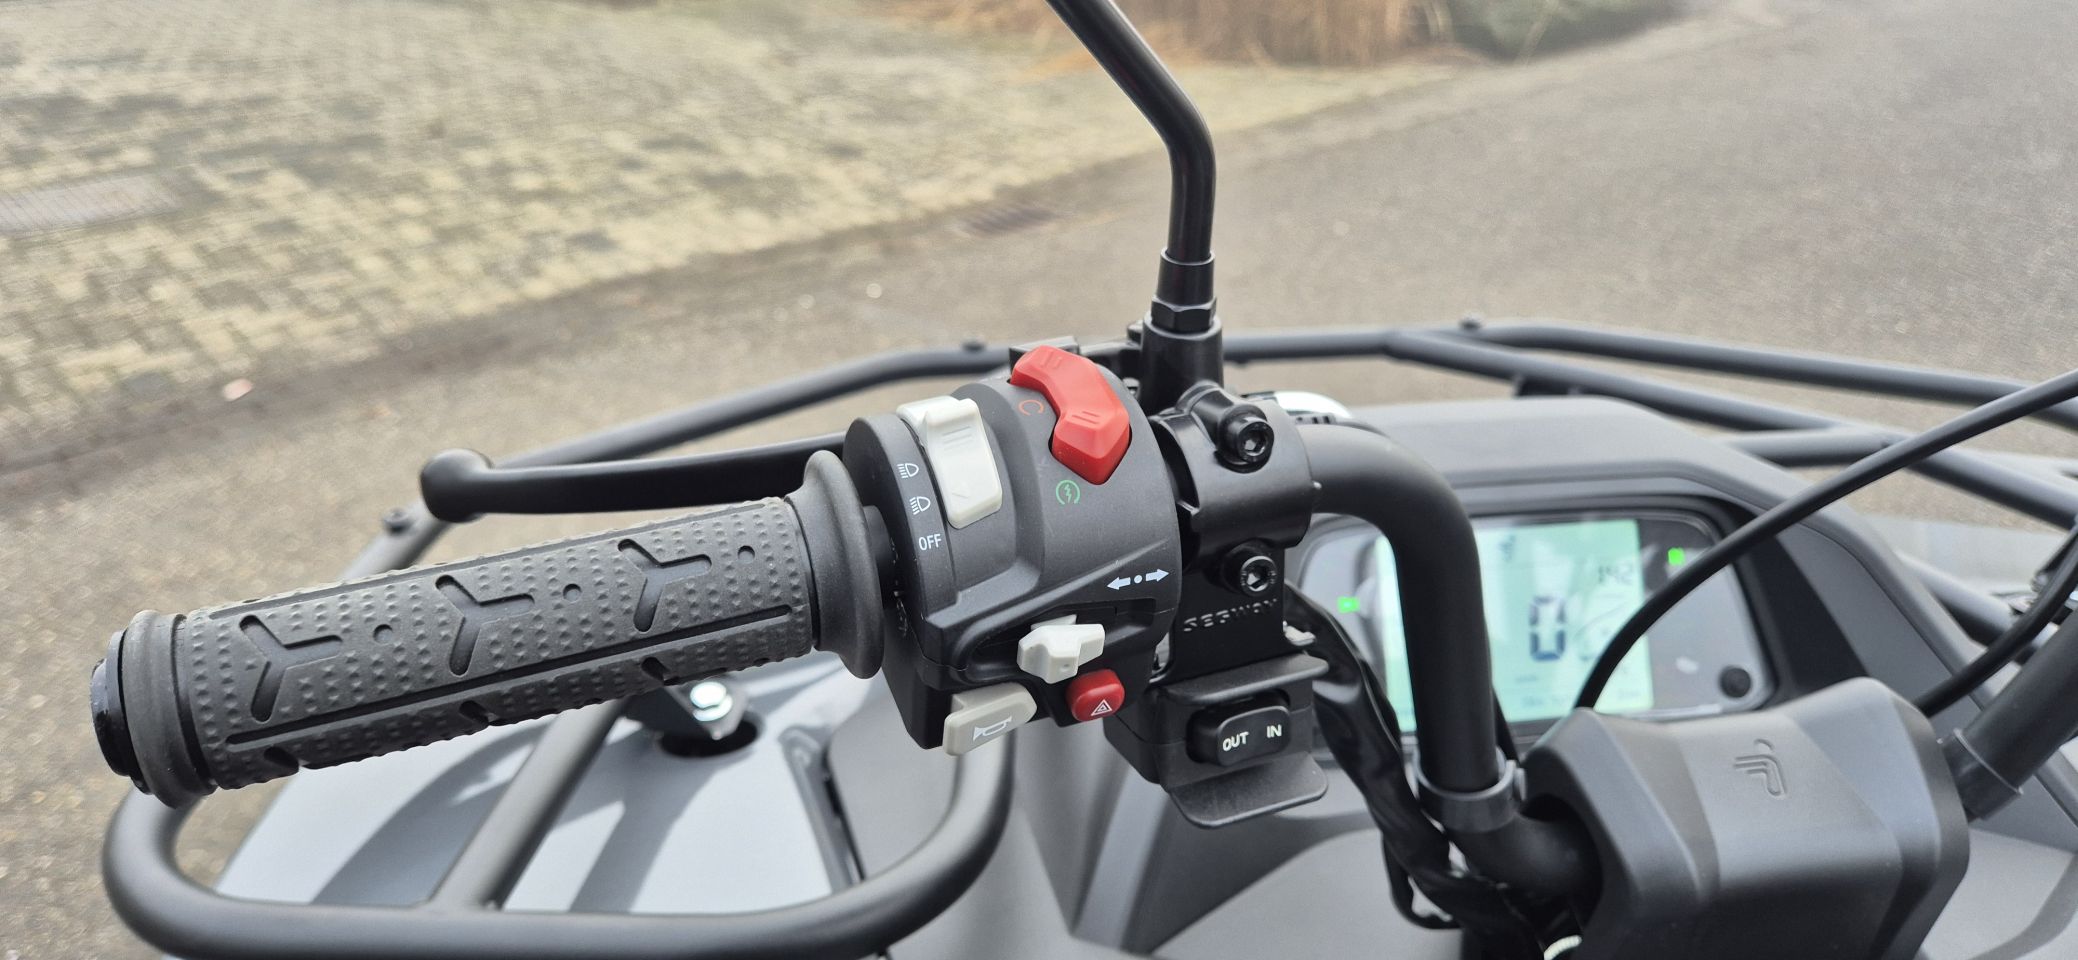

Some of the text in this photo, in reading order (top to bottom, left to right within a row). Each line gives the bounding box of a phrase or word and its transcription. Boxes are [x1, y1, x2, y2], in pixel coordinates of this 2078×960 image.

[918, 533, 942, 551] OFF
[1182, 598, 1278, 632] SEGWAY
[1529, 595, 1567, 662] 0
[1222, 724, 1282, 752] OUT IN
